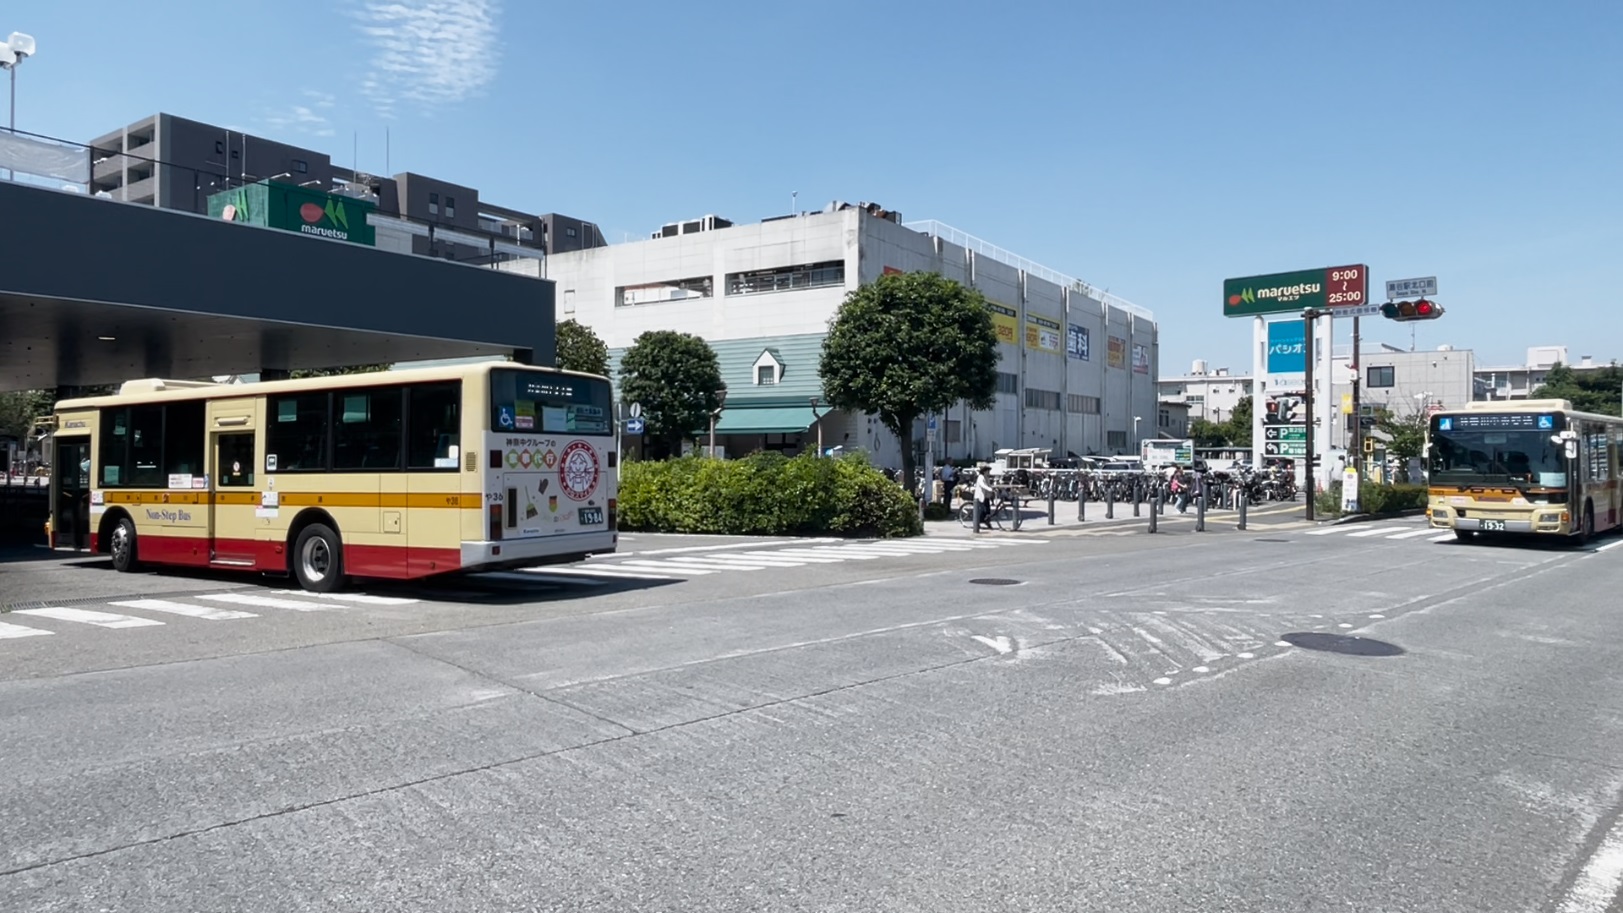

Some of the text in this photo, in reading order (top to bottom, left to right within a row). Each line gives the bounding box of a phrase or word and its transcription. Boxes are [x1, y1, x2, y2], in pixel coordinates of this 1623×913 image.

[301, 224, 348, 239] maruetsu
[1332, 270, 1358, 281] 9:00
[1257, 283, 1320, 298] maruetsu
[1329, 291, 1361, 303] 25:00
[1269, 343, 1306, 355] パシオ
[1280, 428, 1288, 439] P
[1280, 443, 1289, 454] P
[178, 510, 192, 521] Bus
